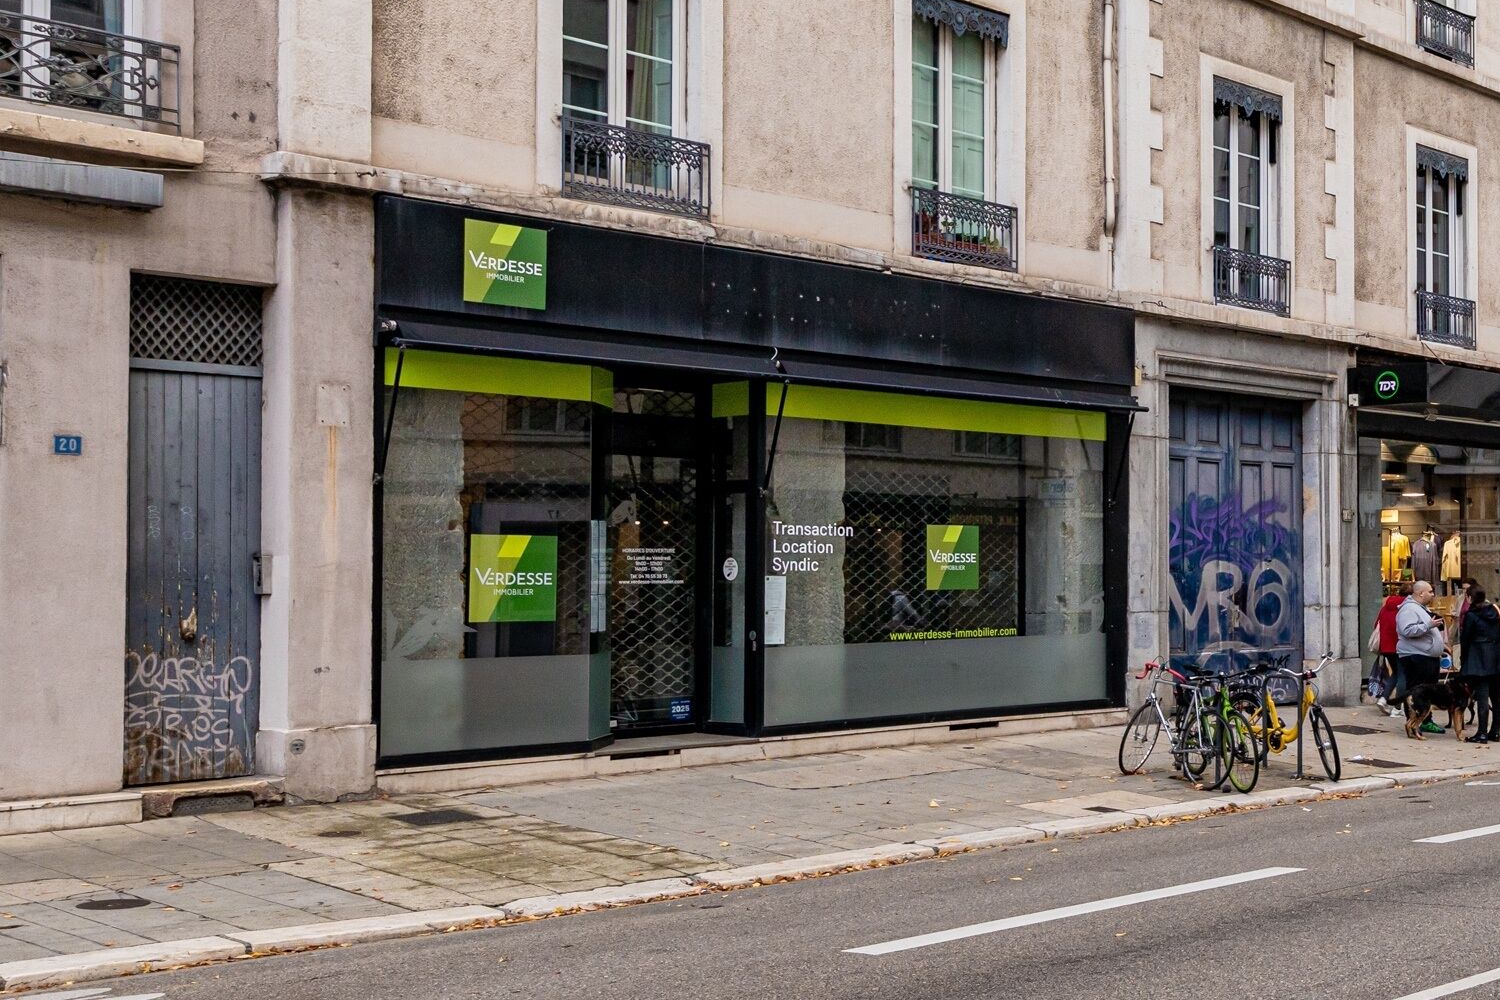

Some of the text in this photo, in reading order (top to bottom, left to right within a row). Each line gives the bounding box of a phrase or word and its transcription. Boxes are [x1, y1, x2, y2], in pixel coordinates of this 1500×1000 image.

[468, 249, 543, 276] VERDESSE
[486, 272, 525, 283] IMMOBILIER
[1379, 380, 1396, 391] TDR
[59, 438, 77, 451] 20
[772, 521, 854, 537] Transaction
[773, 539, 834, 554] Location
[929, 549, 977, 563] VERDESSE
[772, 557, 819, 575] Syndic
[475, 567, 553, 586] VERDESSE
[493, 588, 534, 596] IMMOBILIER
[890, 627, 1017, 641] www.verdesse-immobilier.com
